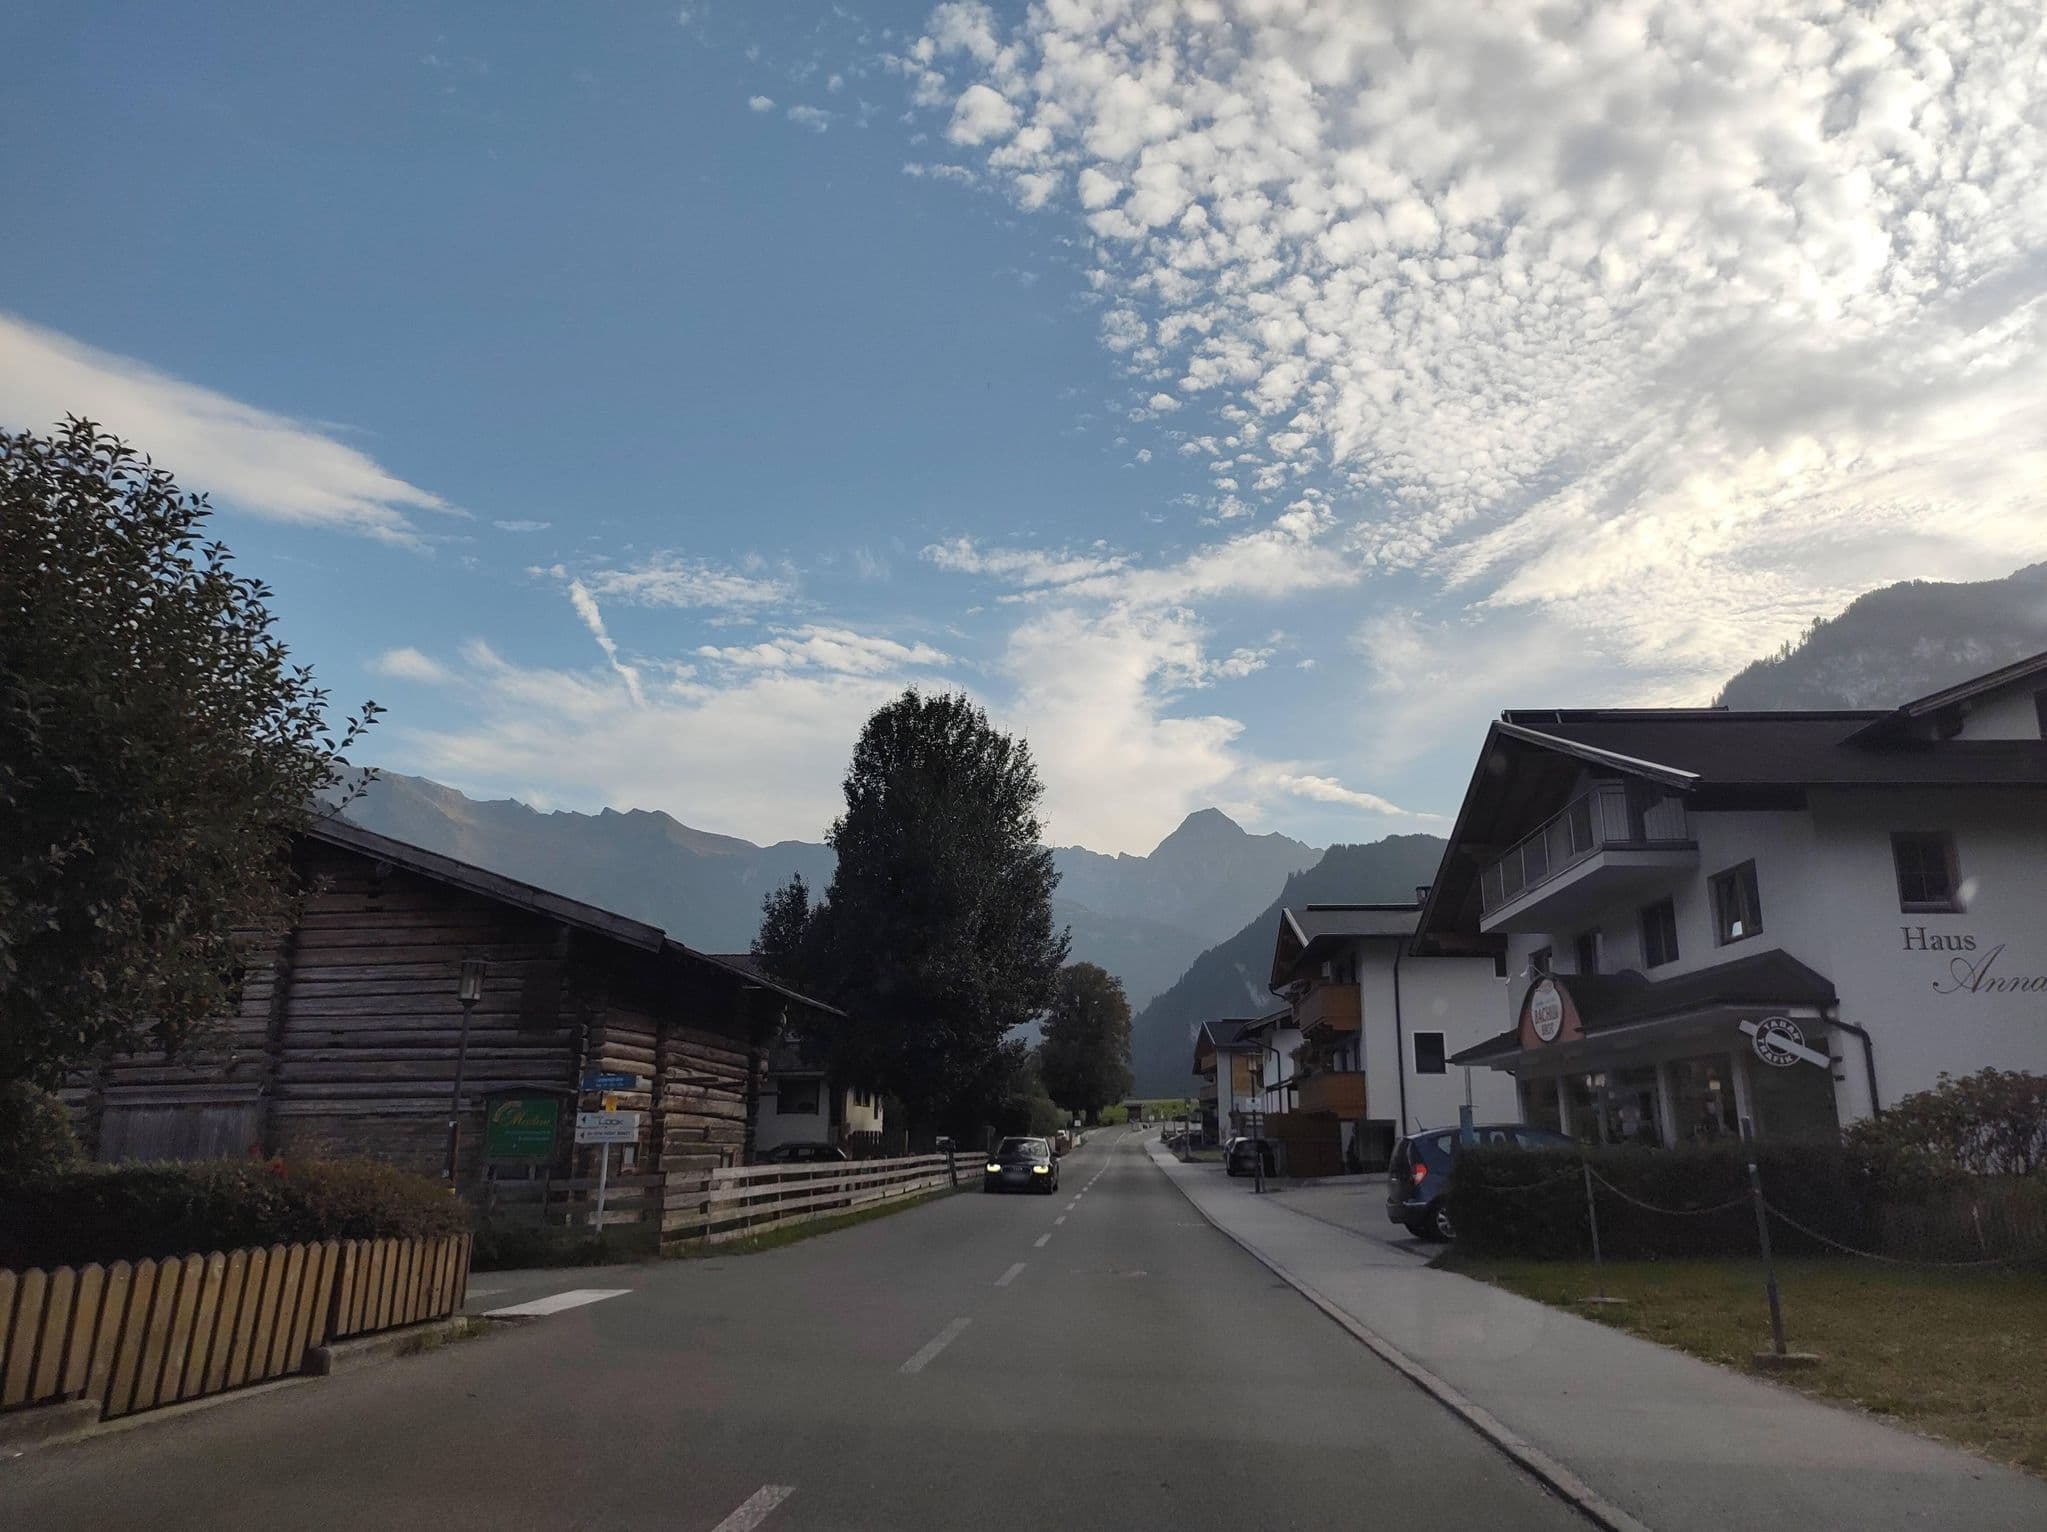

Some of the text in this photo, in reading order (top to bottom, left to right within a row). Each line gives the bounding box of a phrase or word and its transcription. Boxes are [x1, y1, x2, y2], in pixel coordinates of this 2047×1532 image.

[1900, 926, 1977, 951] Haus
[1763, 1020, 1801, 1040] TABAK
[1758, 1038, 1793, 1063] TRAFIK
